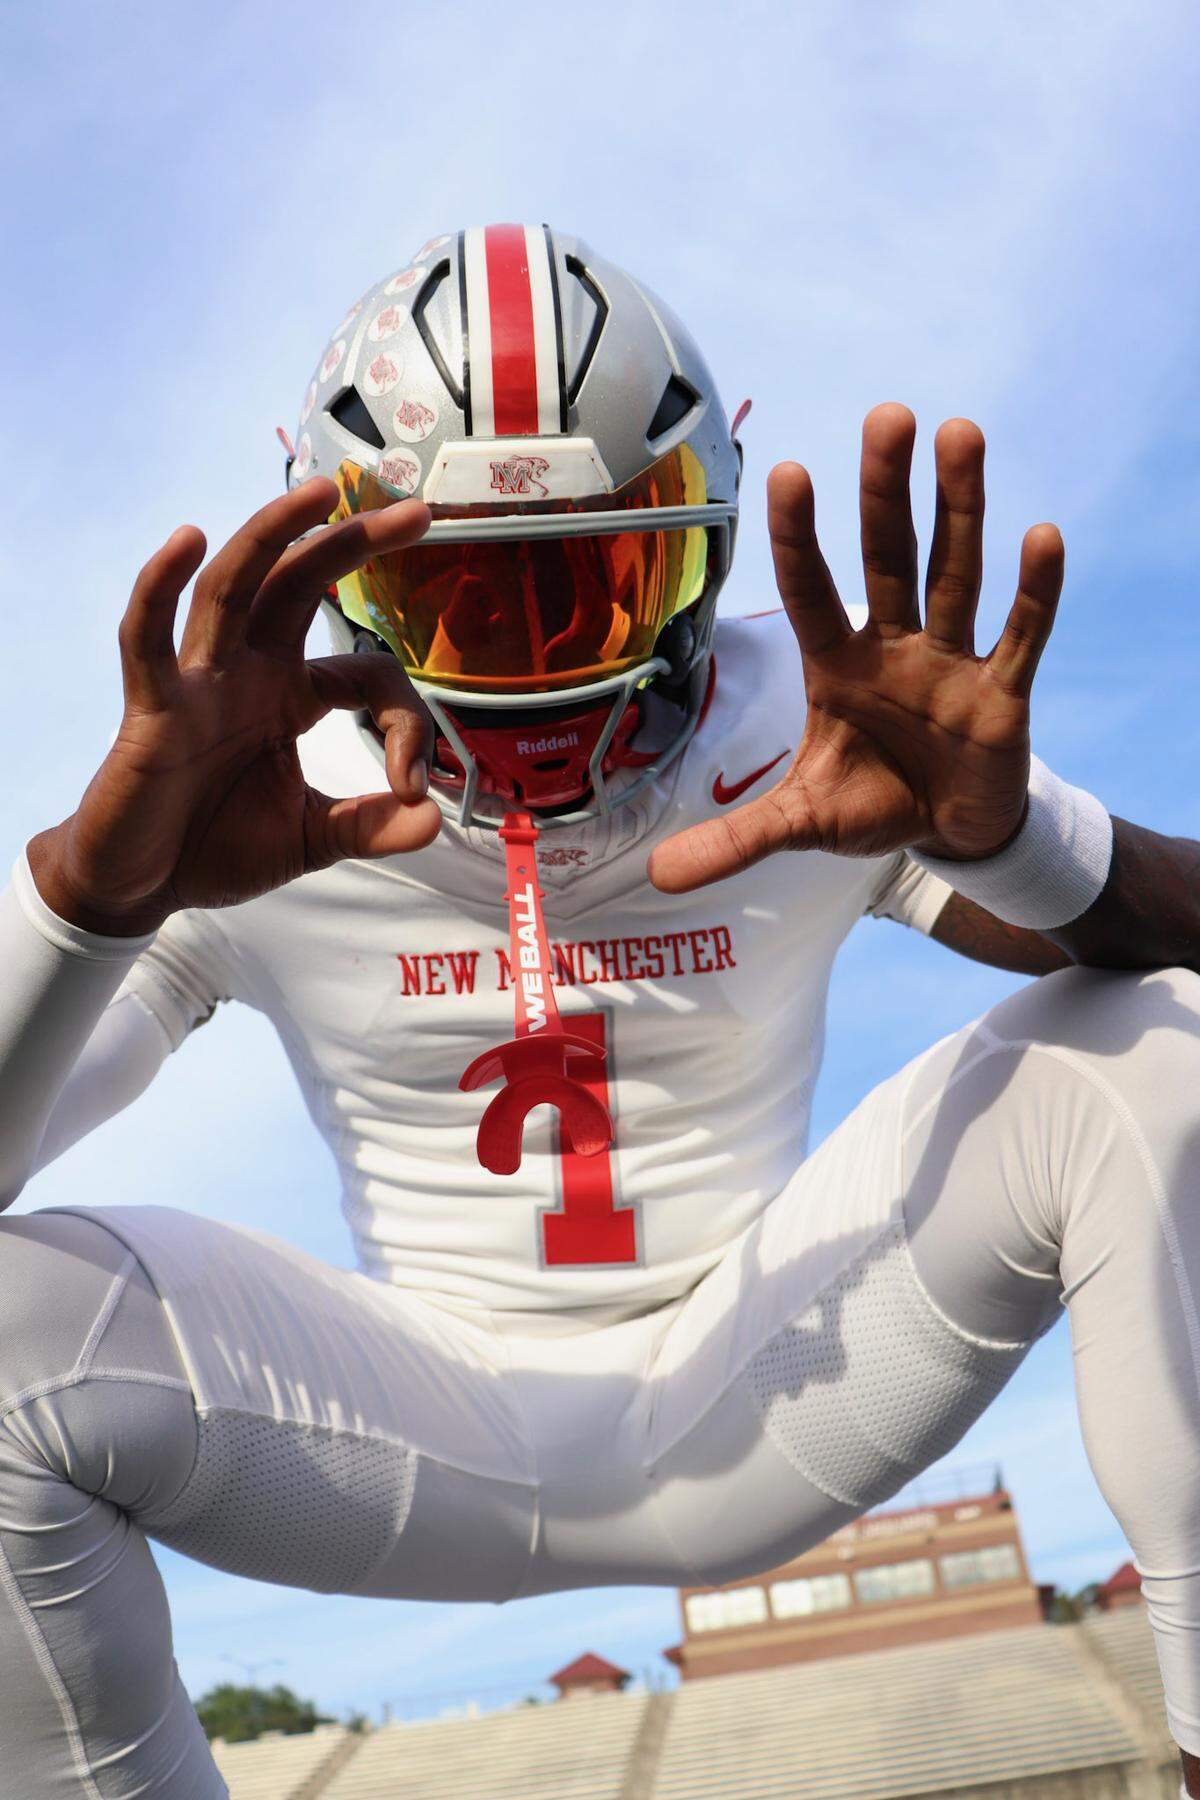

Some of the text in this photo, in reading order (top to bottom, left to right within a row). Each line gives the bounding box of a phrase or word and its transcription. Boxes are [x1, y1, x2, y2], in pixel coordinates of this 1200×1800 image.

[516, 732, 579, 755] Riddell
[398, 925, 737, 996] NEW MNCHESTER
[513, 882, 547, 1033] WE BALL
[536, 1006, 645, 1272] 1
